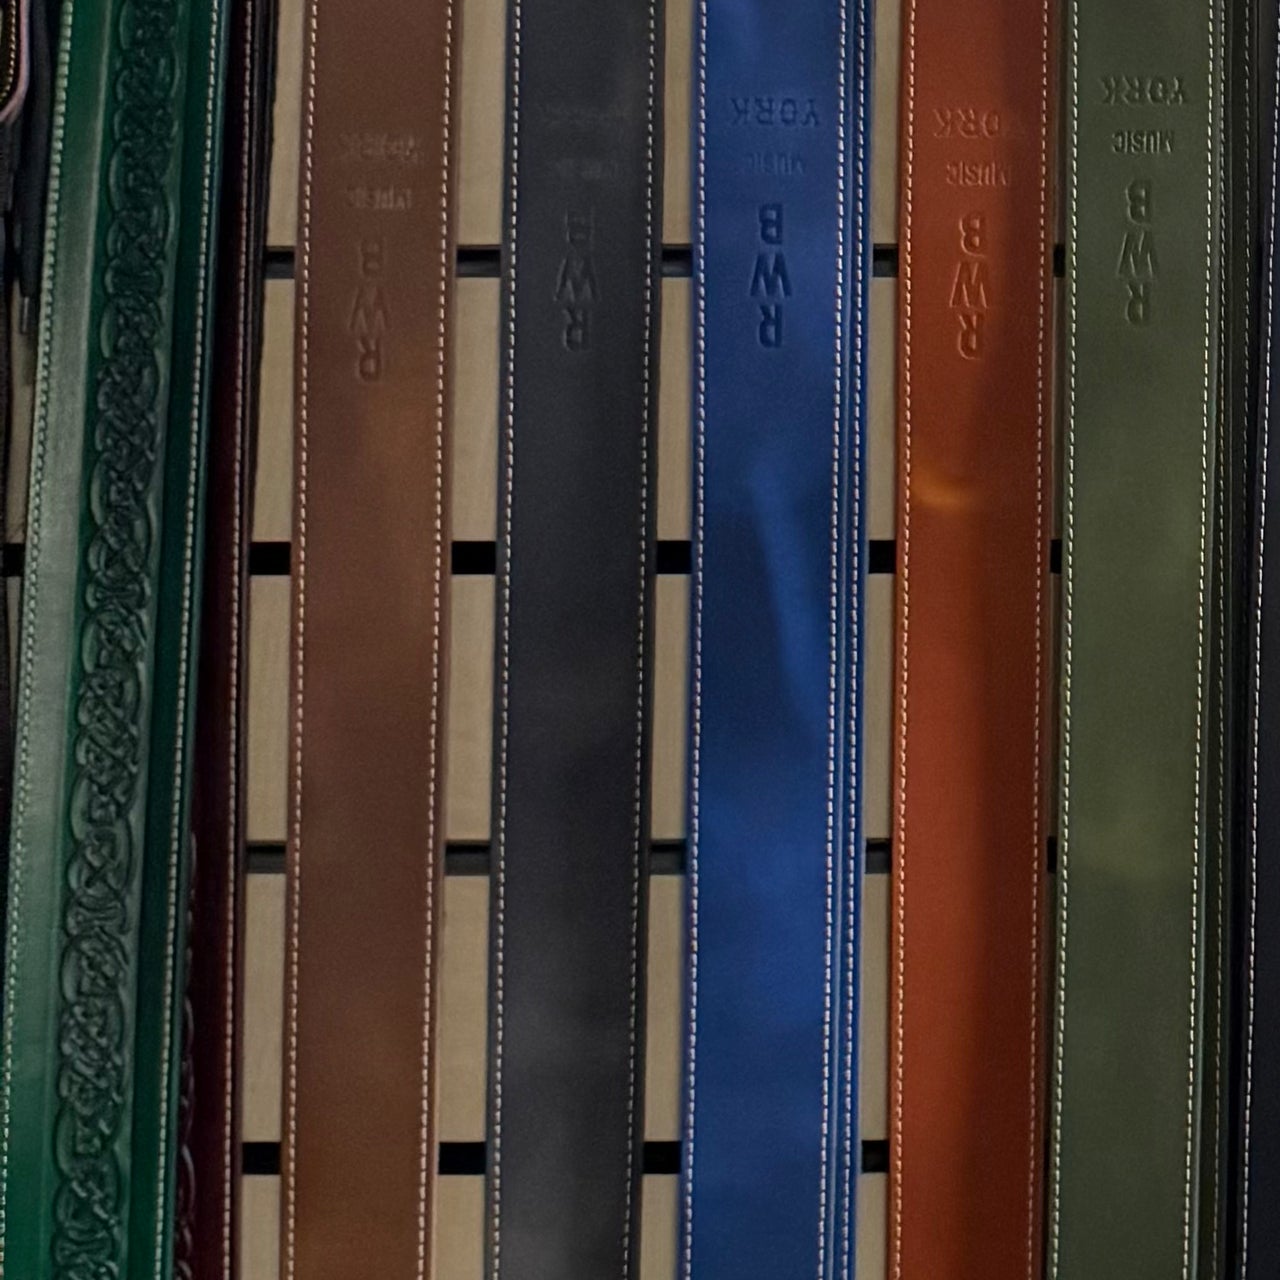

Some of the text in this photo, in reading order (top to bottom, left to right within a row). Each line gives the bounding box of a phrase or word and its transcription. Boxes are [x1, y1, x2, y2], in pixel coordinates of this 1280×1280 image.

[1098, 73, 1191, 107] YORK
[729, 95, 823, 128] YORK
[1112, 127, 1177, 156] MUSIC
